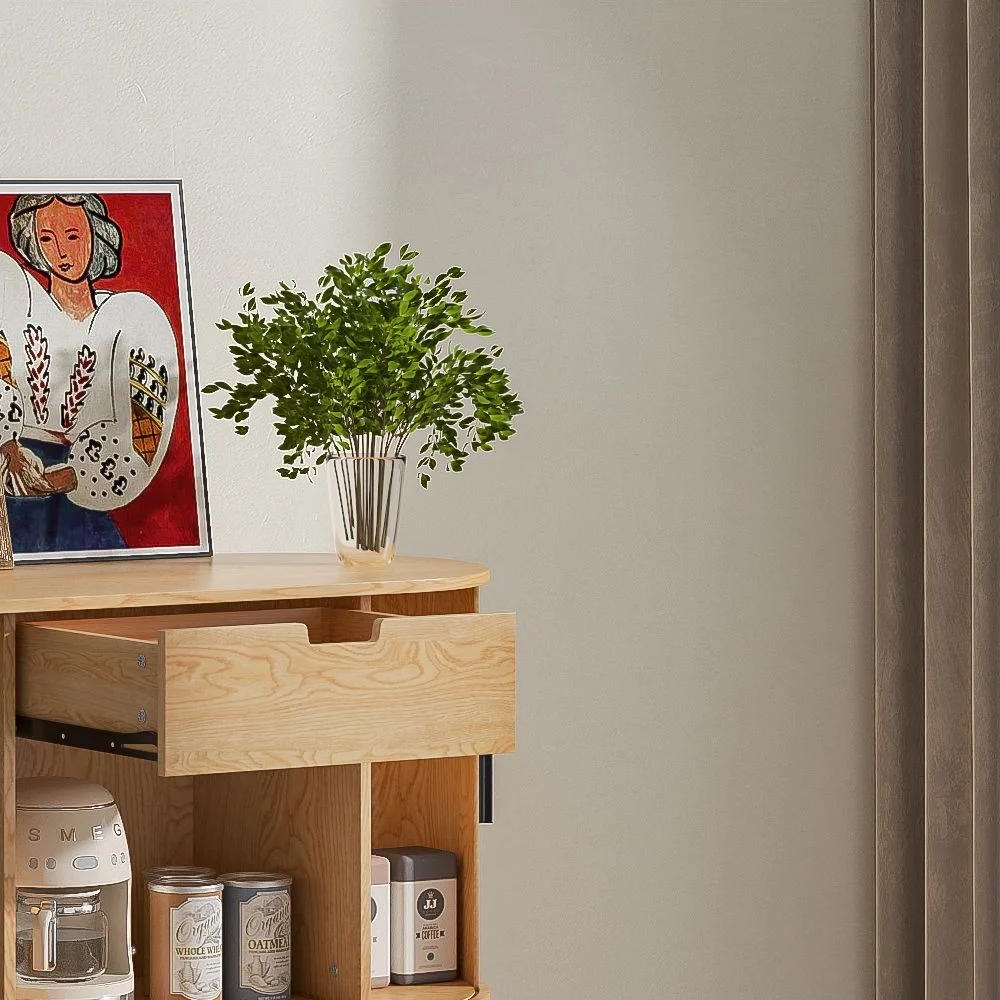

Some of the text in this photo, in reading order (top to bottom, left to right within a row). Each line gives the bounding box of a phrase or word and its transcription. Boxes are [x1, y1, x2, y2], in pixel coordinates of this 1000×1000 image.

[28, 823, 122, 842] SMEG
[421, 929, 440, 940] COFFEE
[175, 947, 206, 956] WHOLE
